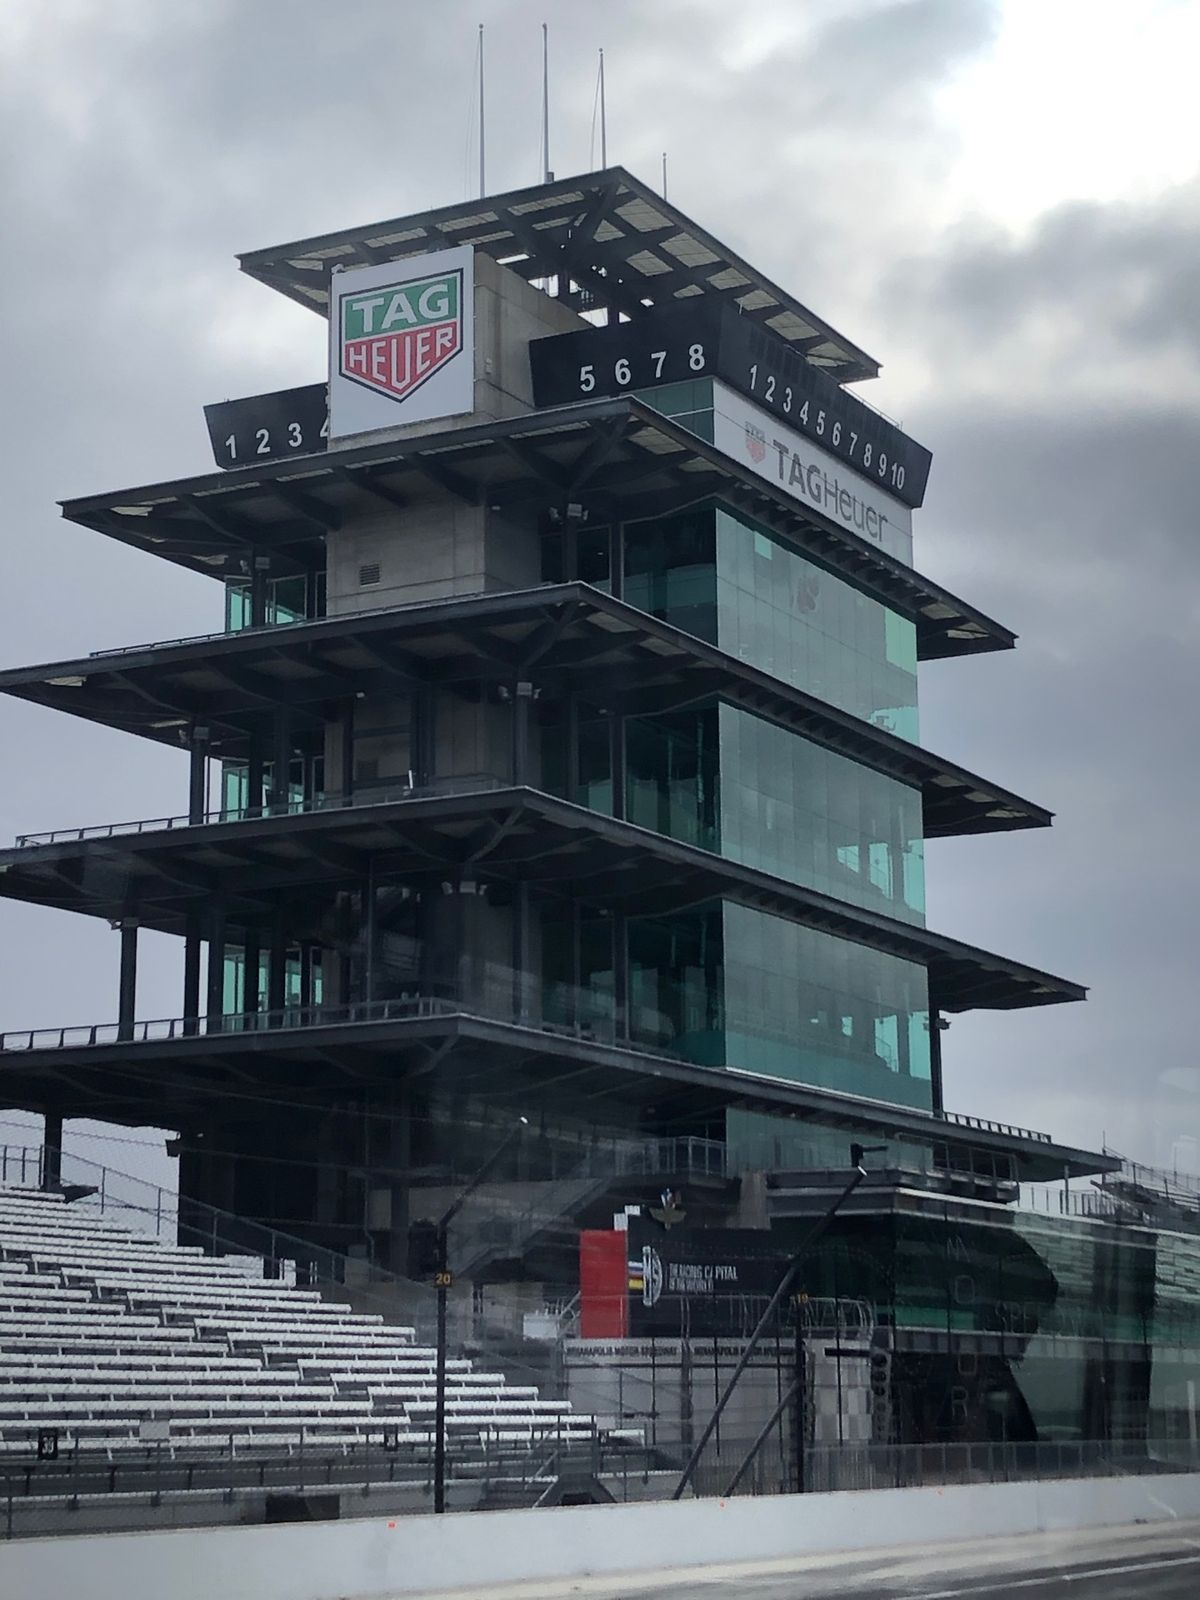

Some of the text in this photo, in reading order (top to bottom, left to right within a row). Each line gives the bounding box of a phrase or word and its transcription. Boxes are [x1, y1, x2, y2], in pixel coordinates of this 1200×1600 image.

[352, 284, 449, 333] TAG
[349, 326, 453, 388] HEUER
[579, 343, 706, 392] 5 6 7 8
[225, 434, 237, 459] 1
[255, 428, 271, 454] 2
[288, 422, 303, 447] 3
[750, 364, 905, 490] 1 2 3 4 5 6 7 8 9 10
[435, 1272, 451, 1285] 20
